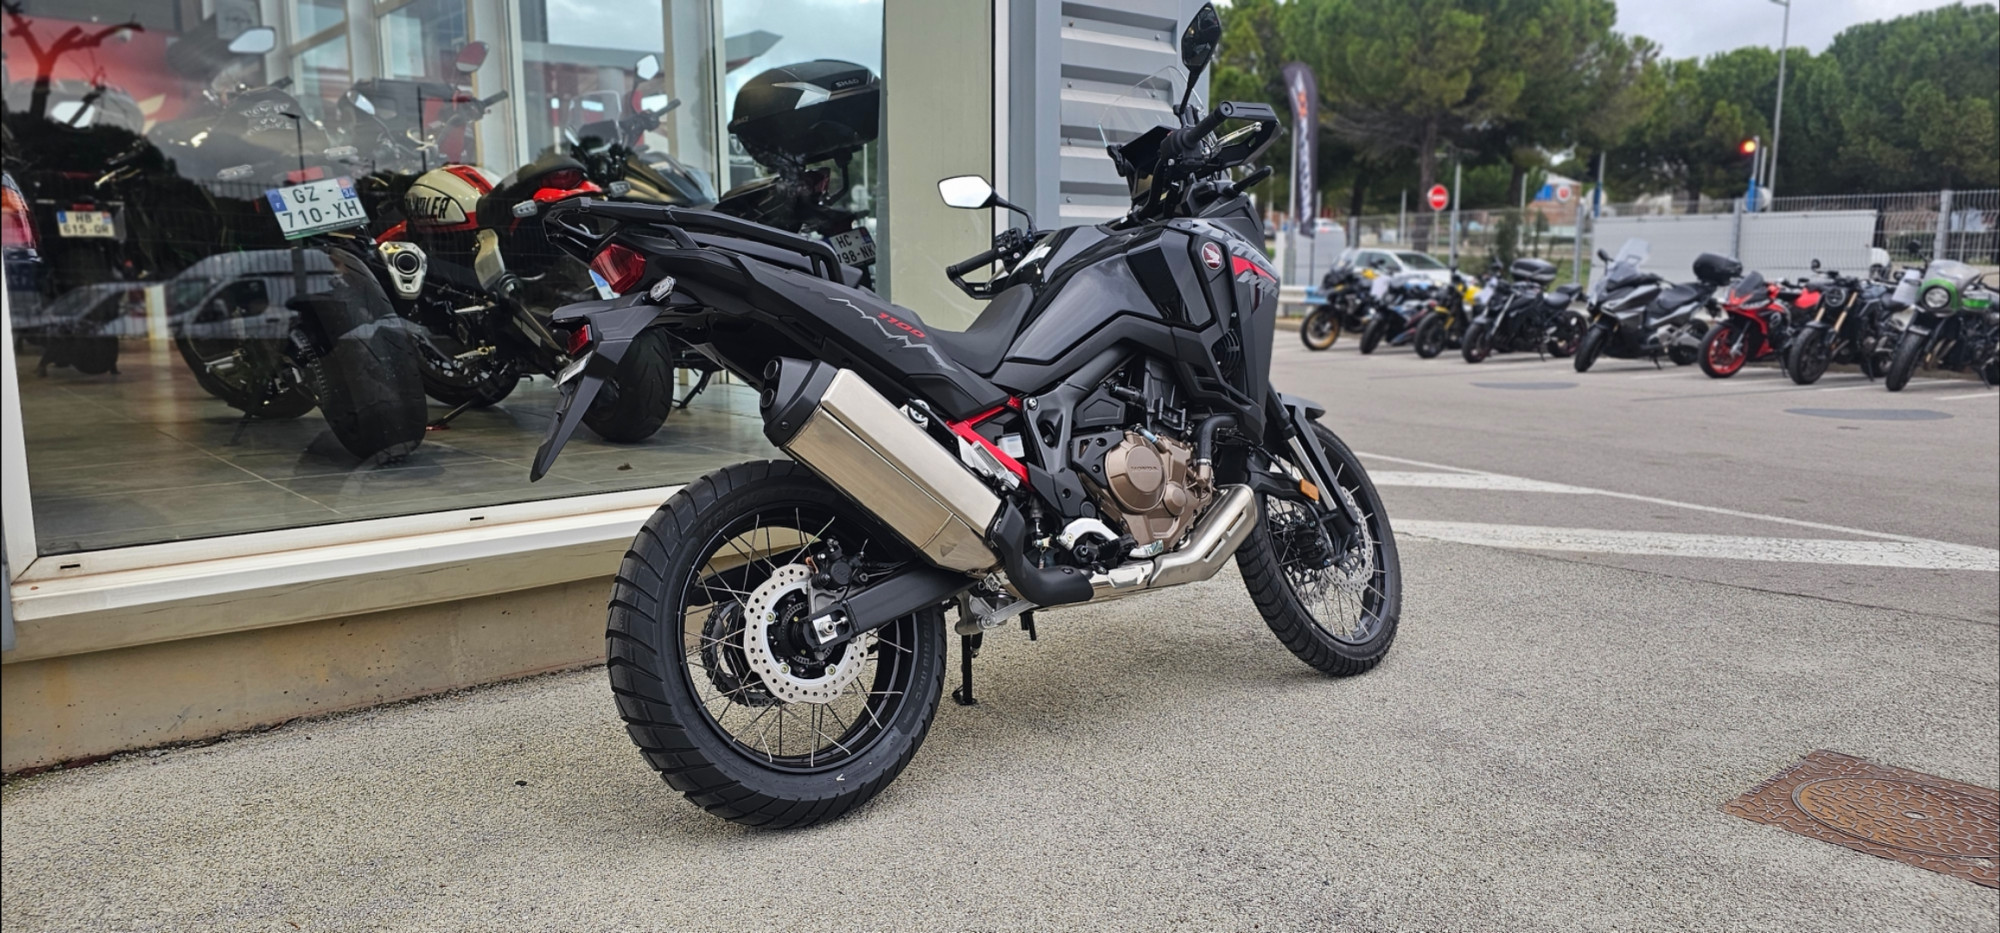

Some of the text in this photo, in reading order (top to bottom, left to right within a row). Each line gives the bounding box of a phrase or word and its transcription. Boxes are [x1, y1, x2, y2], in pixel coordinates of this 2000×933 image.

[291, 185, 320, 204] GZ
[282, 200, 360, 229] 710-XH
[836, 234, 853, 249] HC
[877, 311, 926, 339] 1100
